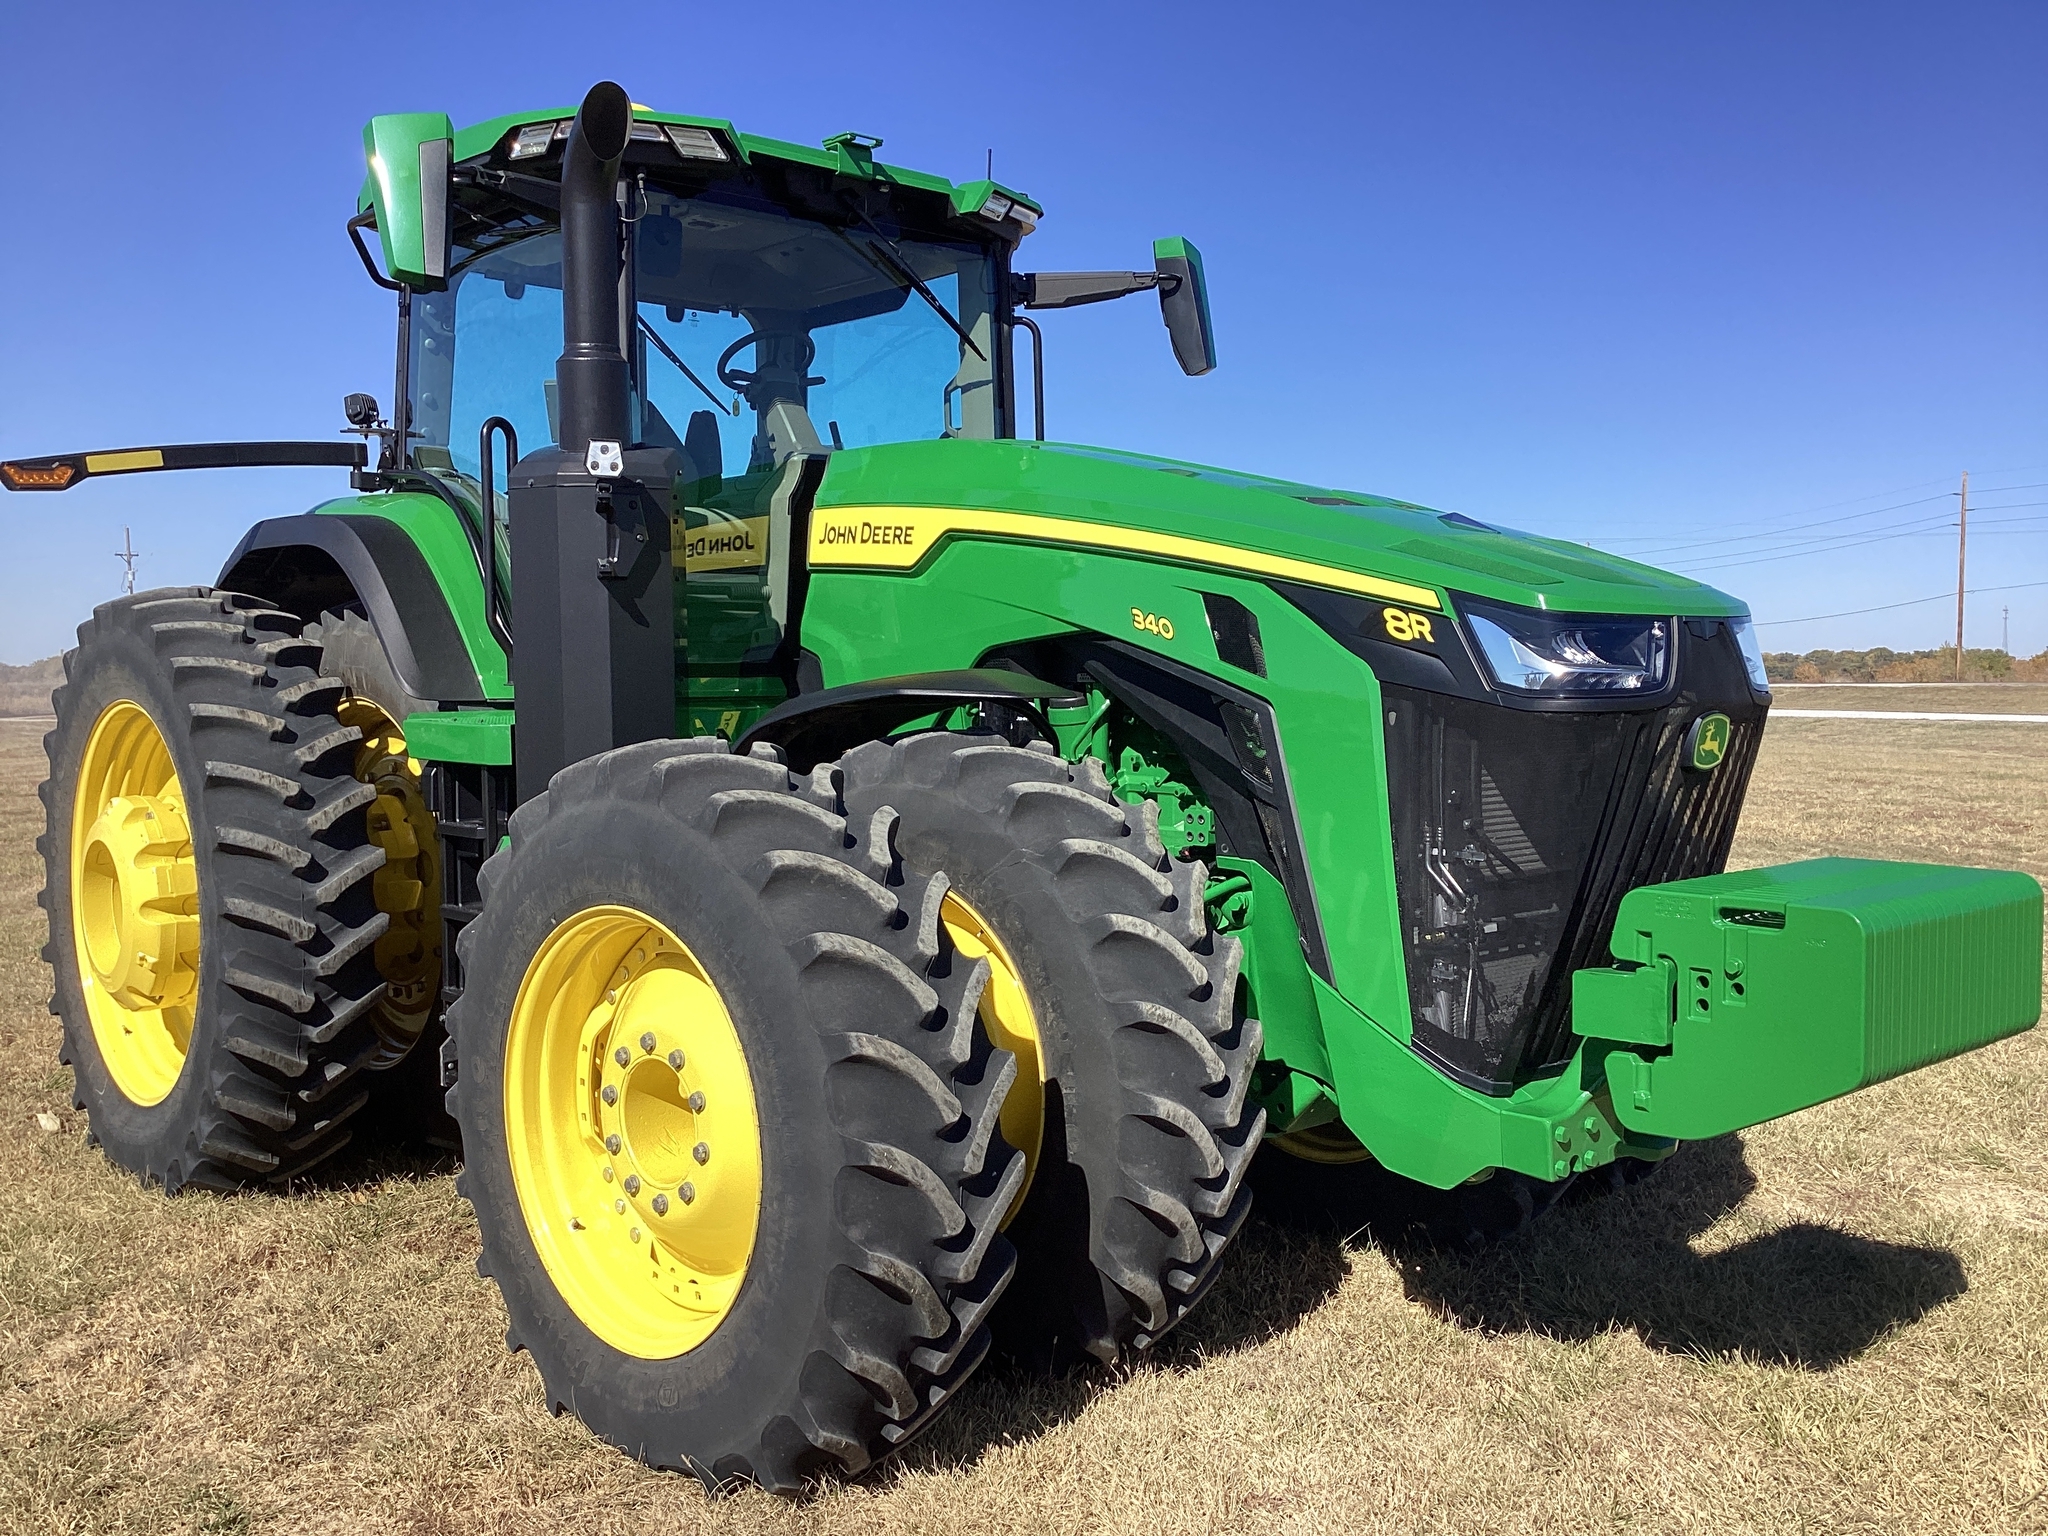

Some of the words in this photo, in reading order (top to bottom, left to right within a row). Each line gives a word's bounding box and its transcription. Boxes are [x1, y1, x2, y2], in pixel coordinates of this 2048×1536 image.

[819, 522, 857, 545] JOHN
[860, 522, 915, 545] DEERE
[1130, 606, 1175, 640] 340
[1382, 607, 1435, 643] 8R
